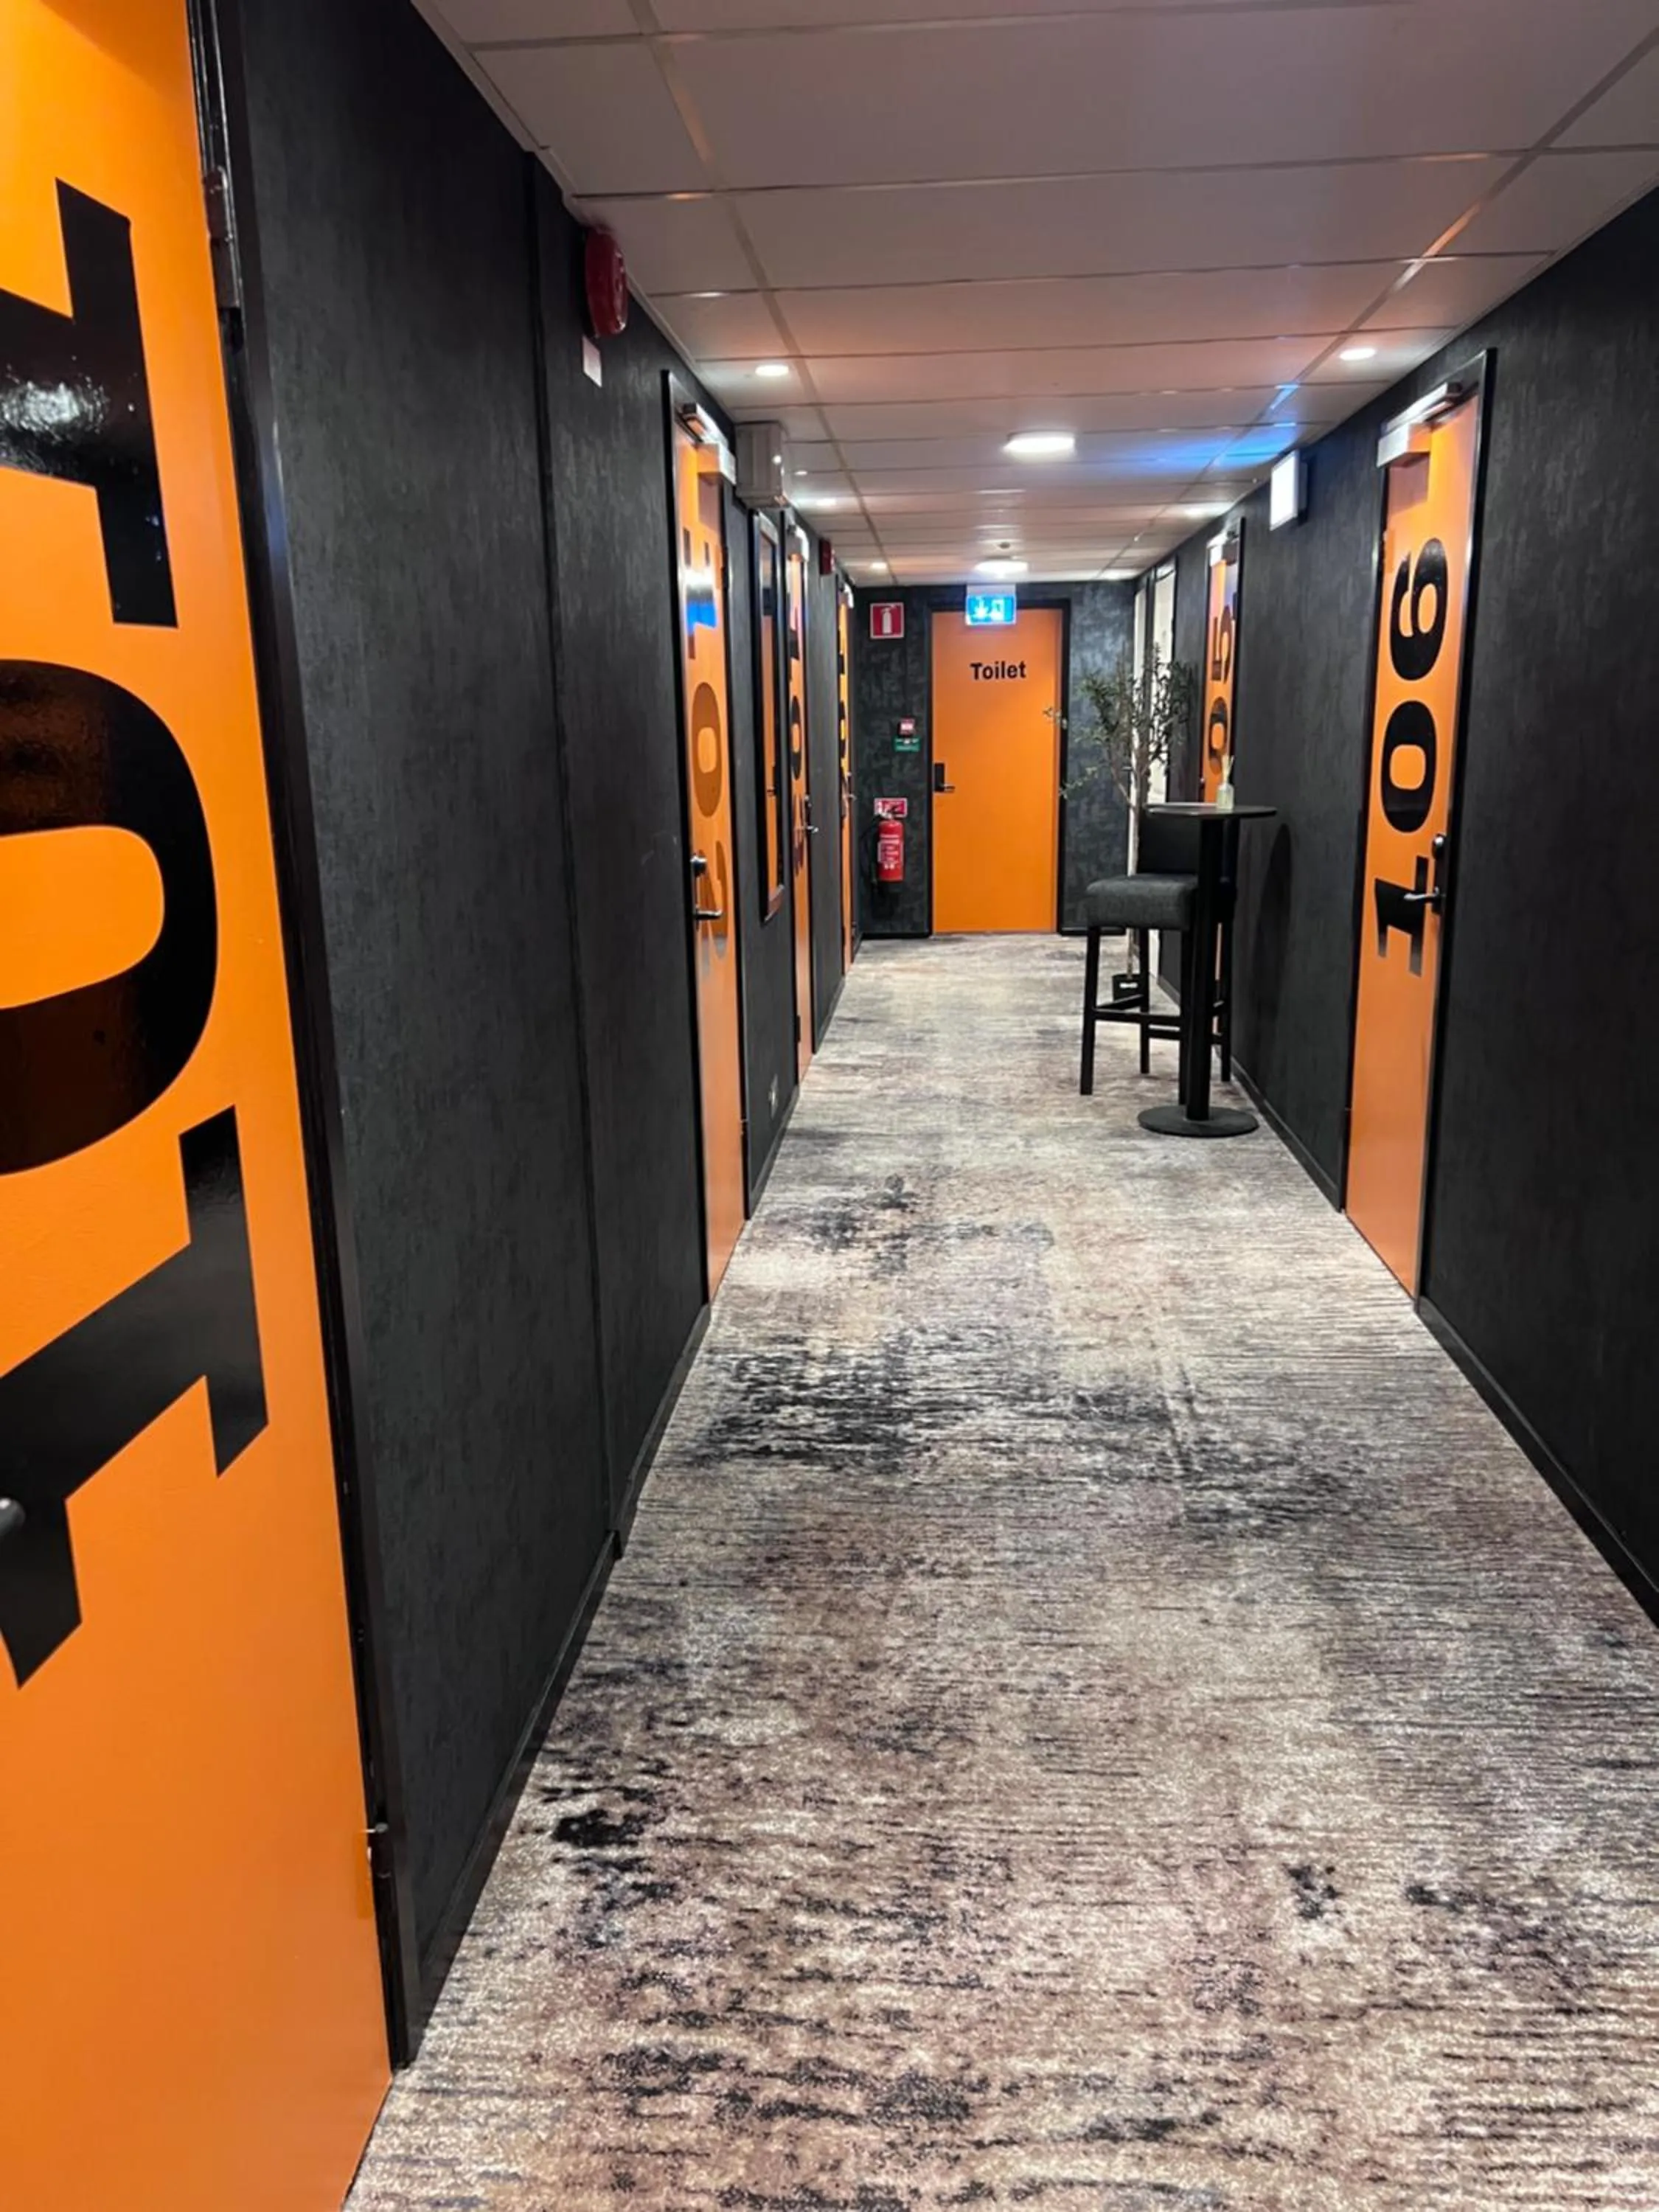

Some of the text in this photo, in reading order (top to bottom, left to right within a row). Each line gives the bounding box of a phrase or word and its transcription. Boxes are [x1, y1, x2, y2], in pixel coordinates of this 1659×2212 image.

[970, 661, 1026, 679] Toilet
[1208, 605, 1232, 774] 05
[1374, 538, 1448, 978] 106
